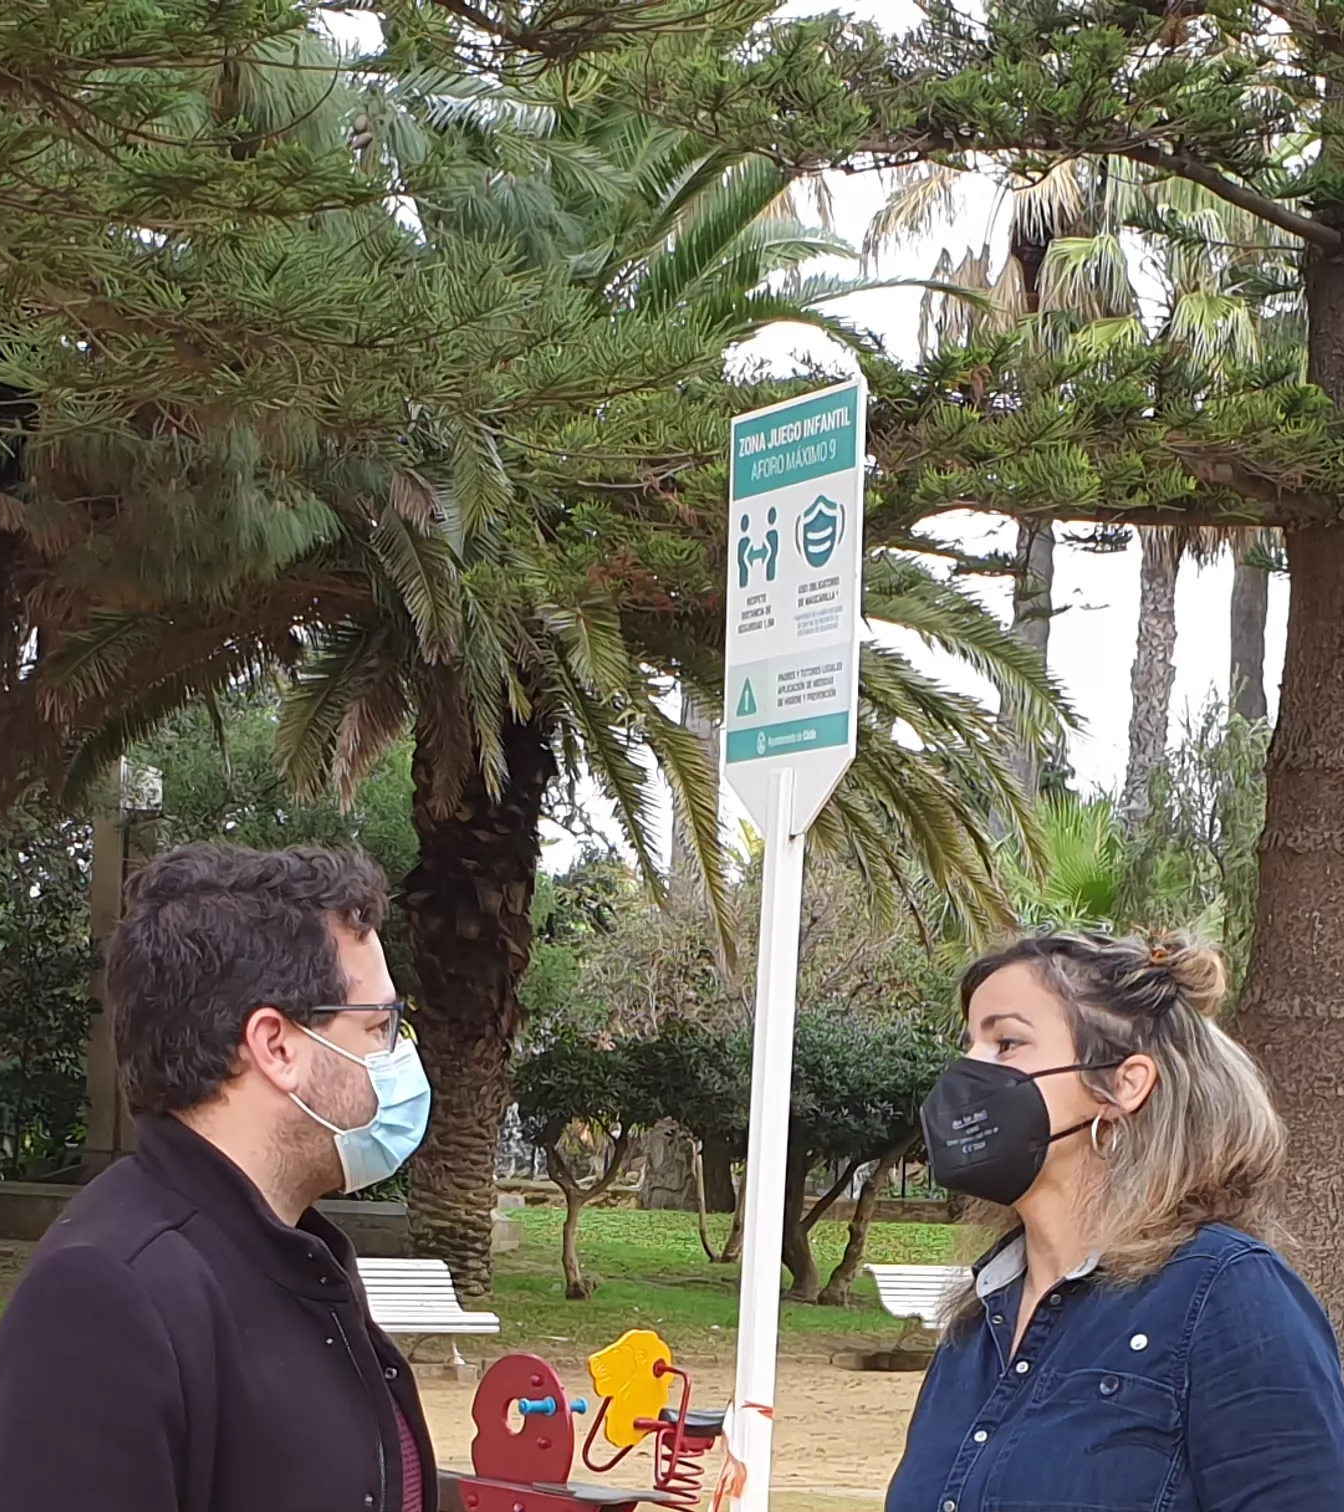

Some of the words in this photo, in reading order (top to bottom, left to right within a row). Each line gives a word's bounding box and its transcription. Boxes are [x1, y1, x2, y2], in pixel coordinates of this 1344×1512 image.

[739, 433, 766, 458] ZONA
[768, 421, 801, 448] JUEGO
[804, 406, 851, 437] INFANTIL
[751, 457, 785, 481] AFORO
[786, 440, 827, 471] MÁXIMO
[829, 438, 837, 460] 9
